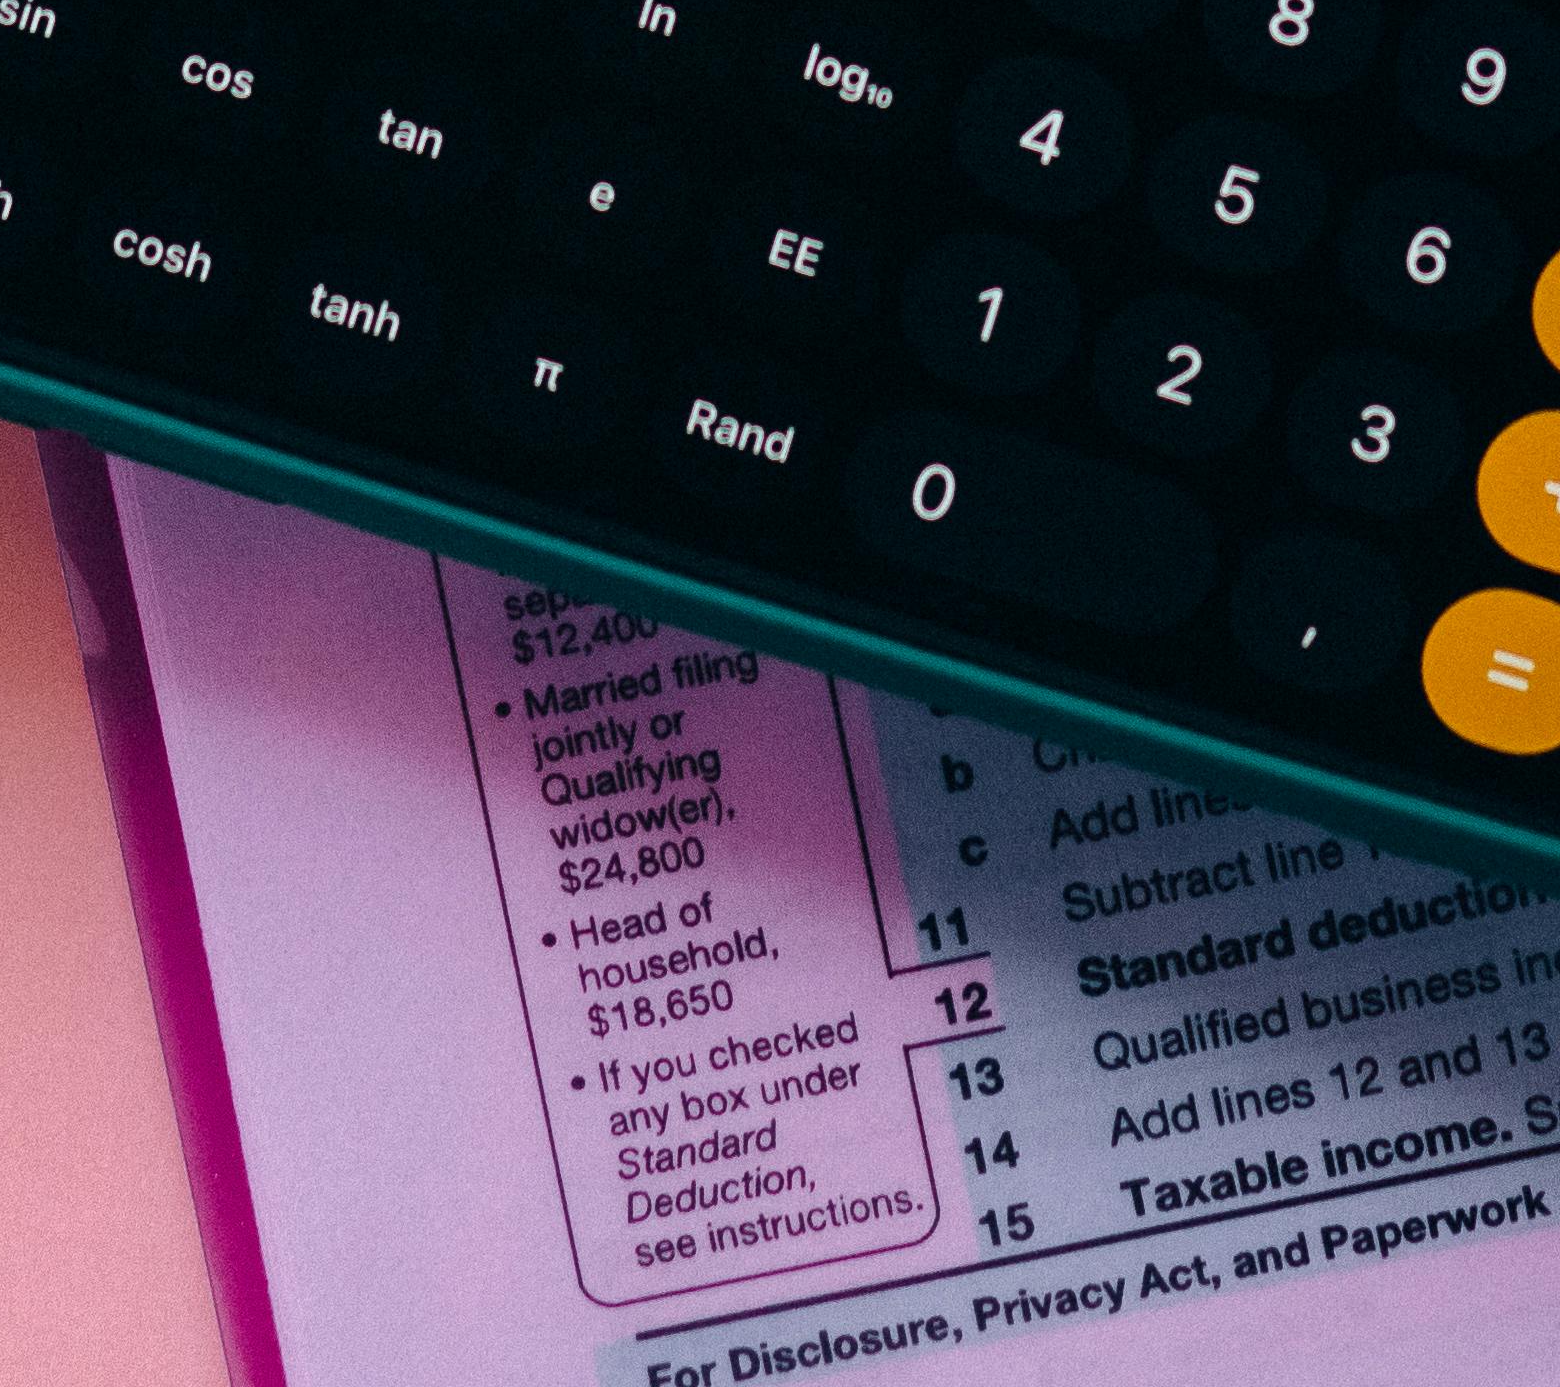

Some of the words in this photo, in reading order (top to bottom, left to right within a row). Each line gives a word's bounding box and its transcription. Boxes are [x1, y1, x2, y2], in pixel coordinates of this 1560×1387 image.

[180, 54, 255, 100] cos
[1460, 46, 1508, 106] 9
[377, 108, 444, 160] tan
[1018, 108, 1065, 166] 4
[588, 180, 616, 213] e
[1213, 164, 1261, 226] 5
[112, 228, 212, 283] cosh
[767, 228, 825, 278] EE
[1405, 225, 1452, 285] 6
[309, 283, 401, 342] tanh
[977, 286, 1004, 343] 1
[533, 356, 565, 393] π
[1155, 344, 1203, 406] 2
[685, 398, 796, 464] Rand
[1350, 403, 1397, 464] 3
[911, 462, 957, 522] 0
[557, 835, 706, 896] $24,800
[586, 978, 734, 1040] $18,650
[617, 1117, 777, 1182] Standard
[626, 1164, 816, 1226] Deduction,
[634, 1234, 697, 1269] see
[707, 1189, 925, 1253] instructions.
